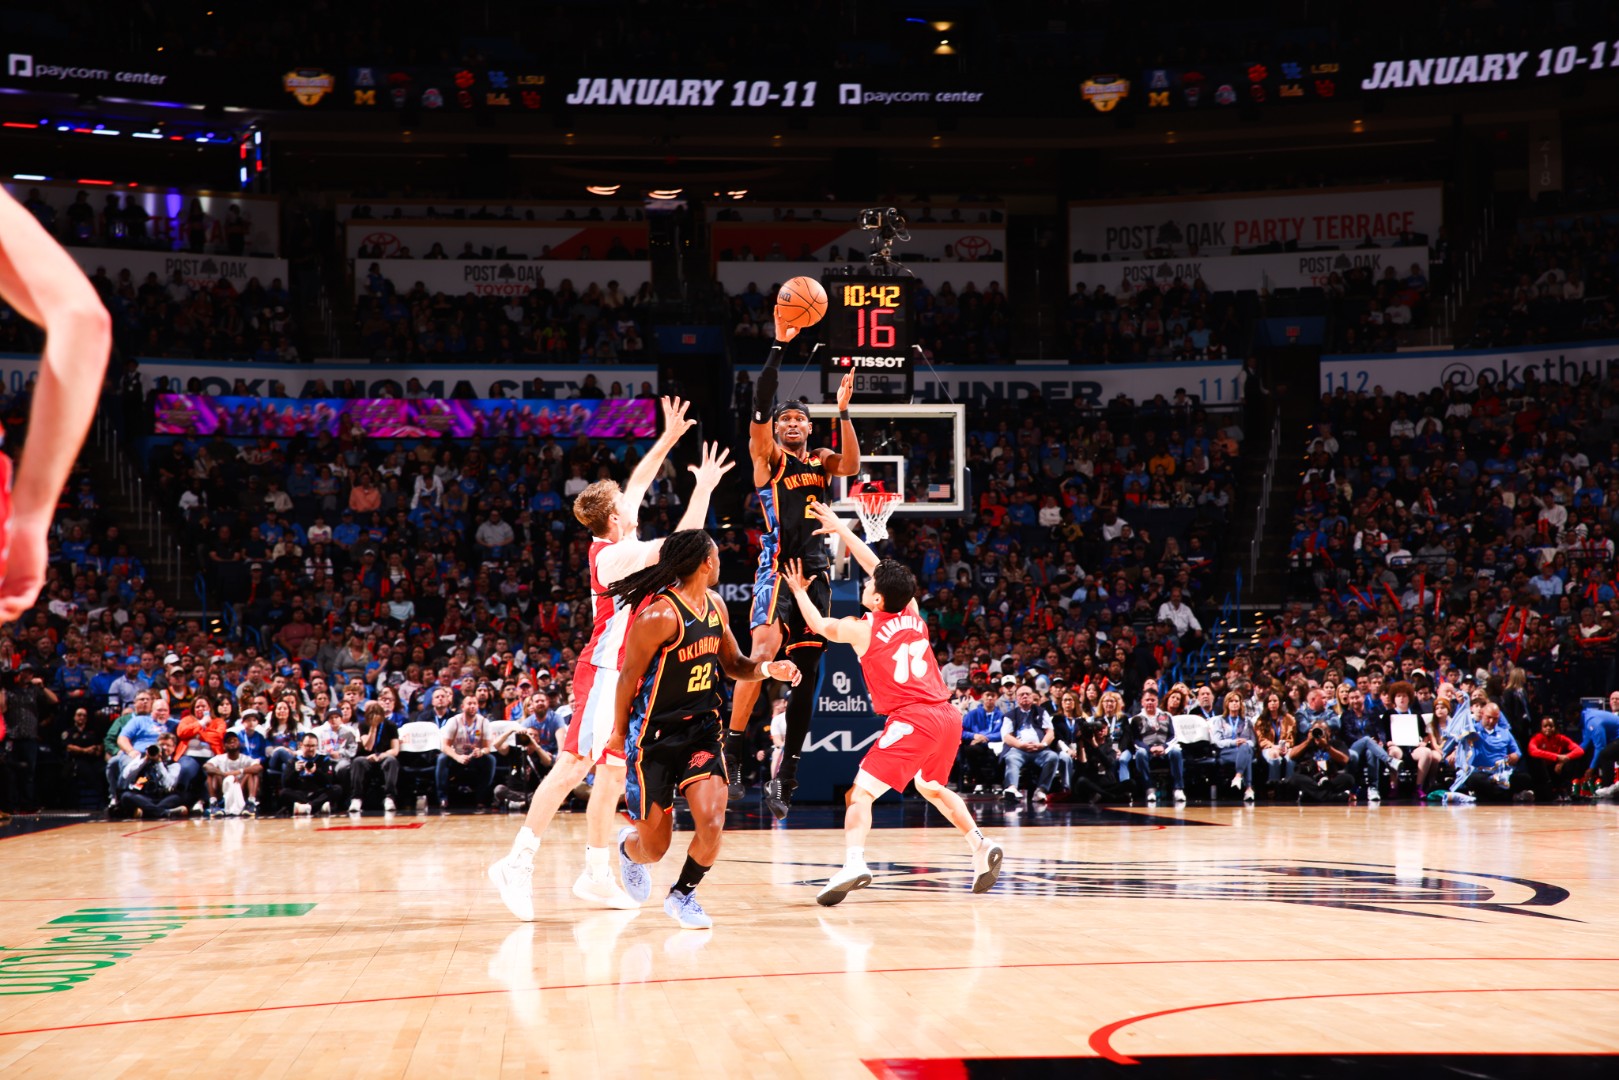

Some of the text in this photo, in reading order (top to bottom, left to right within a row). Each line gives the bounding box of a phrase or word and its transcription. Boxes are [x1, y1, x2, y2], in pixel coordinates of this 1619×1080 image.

[35, 65, 168, 85] paycom center
[1308, 63, 1337, 75] LSU
[1362, 53, 1529, 90] JANUARY
[515, 75, 544, 86] LSU
[565, 79, 722, 106] JANUARY
[730, 81, 817, 107] 10-11
[863, 89, 984, 105] paycom center
[1106, 211, 1414, 251] POST OAK PARTY TERRACE
[165, 259, 247, 279] POST OAK
[463, 265, 544, 282] POST OAK
[1123, 262, 1202, 281] POST OAK
[1299, 255, 1381, 273] POST OAK
[474, 284, 529, 295] TOYOTA
[843, 284, 900, 307] 10:42
[856, 308, 895, 347] 16
[852, 356, 905, 367] TISSOT
[1325, 370, 1369, 394] 112
[804, 494, 817, 519] 2
[678, 635, 720, 663] OKLAHOM
[892, 638, 929, 684] 13
[686, 662, 712, 693] 22
[832, 671, 851, 695] OU
[818, 695, 868, 712] Health
